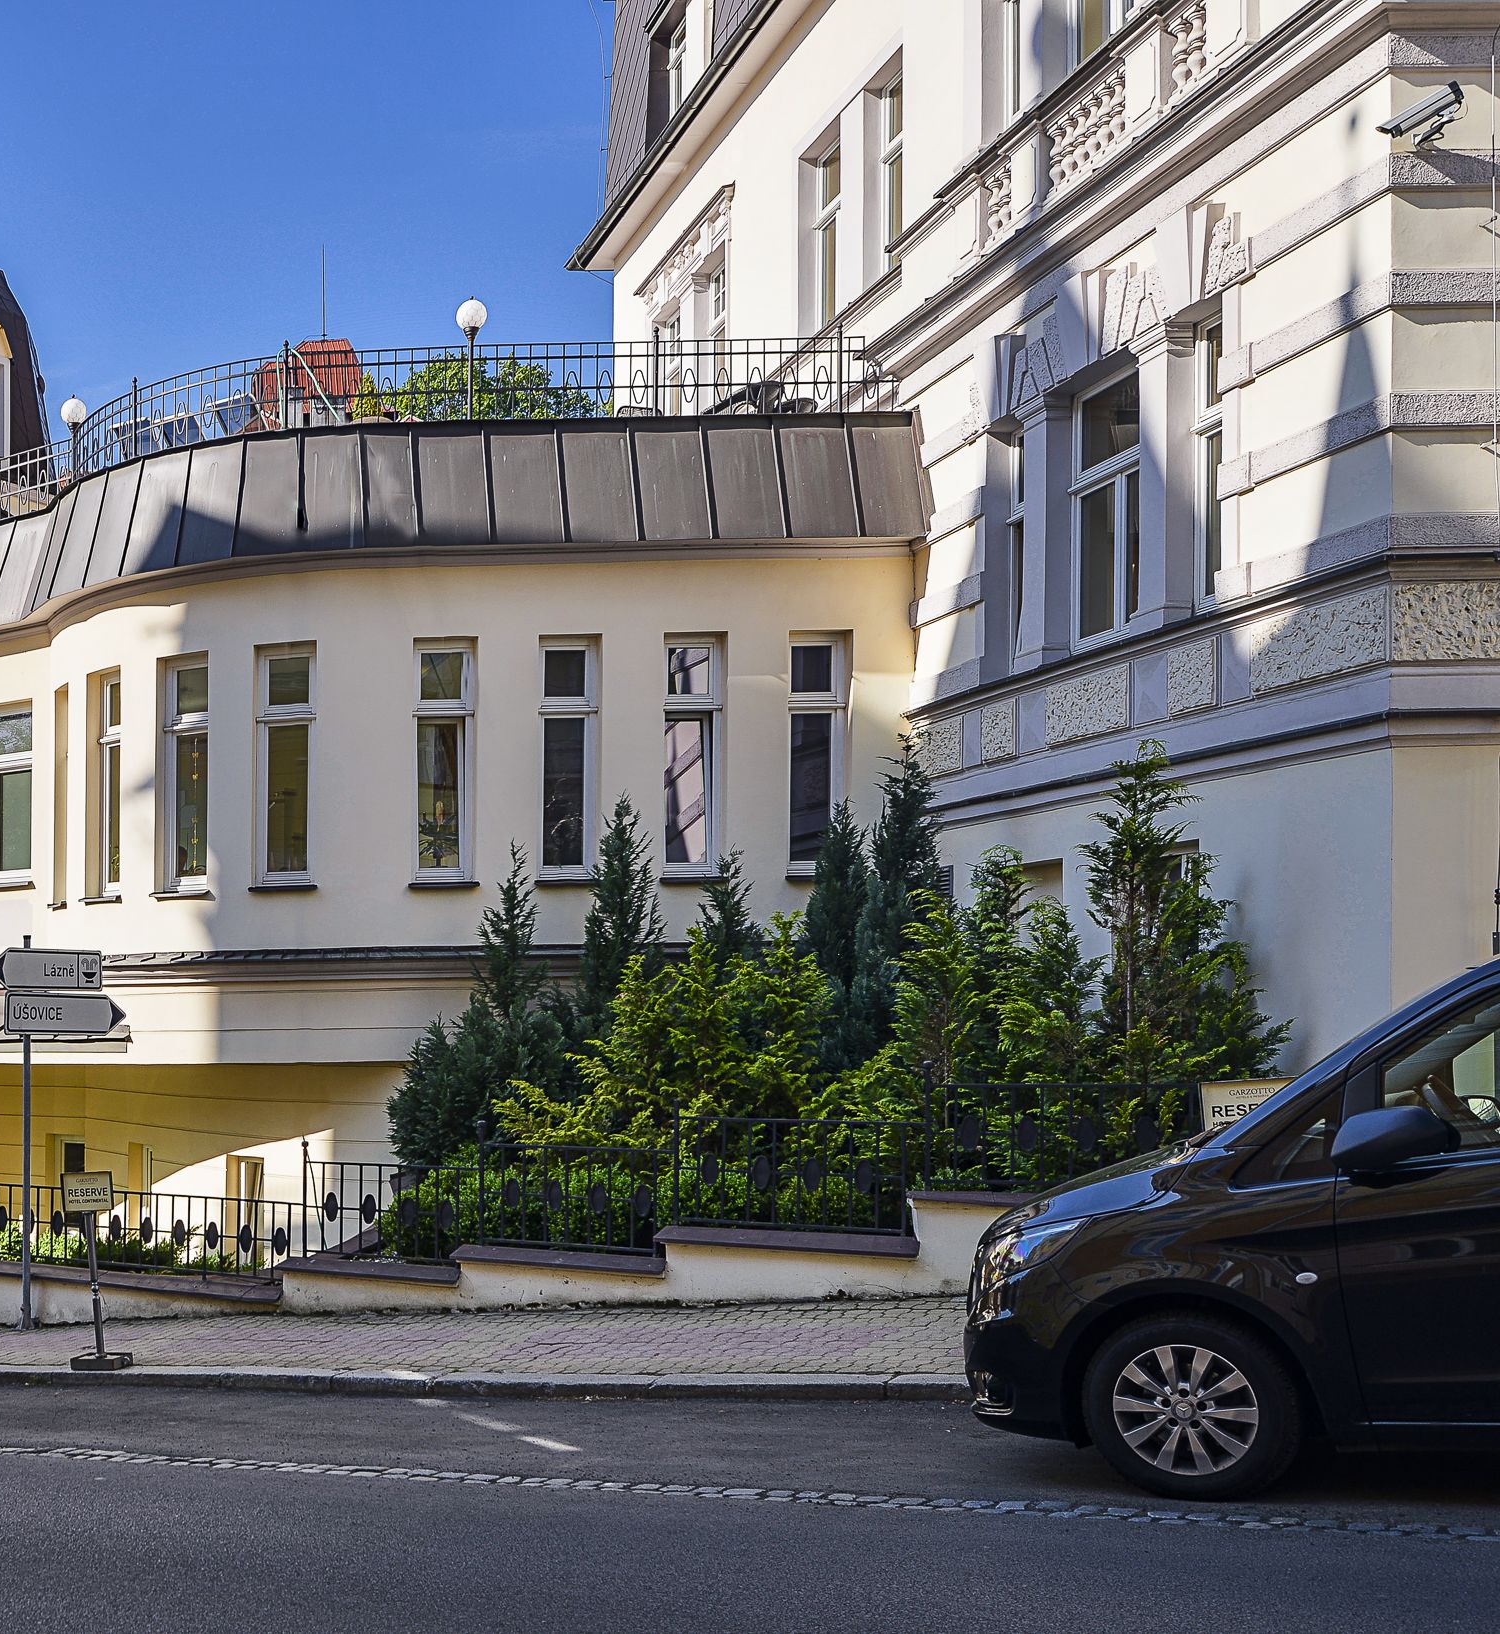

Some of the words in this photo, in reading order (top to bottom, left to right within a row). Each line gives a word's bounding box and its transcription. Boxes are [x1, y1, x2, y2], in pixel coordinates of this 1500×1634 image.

[43, 962, 75, 978] Lázně
[13, 1003, 63, 1021] ÚŠOVICE
[1229, 1087, 1275, 1096] GARZOTTO
[68, 1187, 108, 1197] RESERVE
